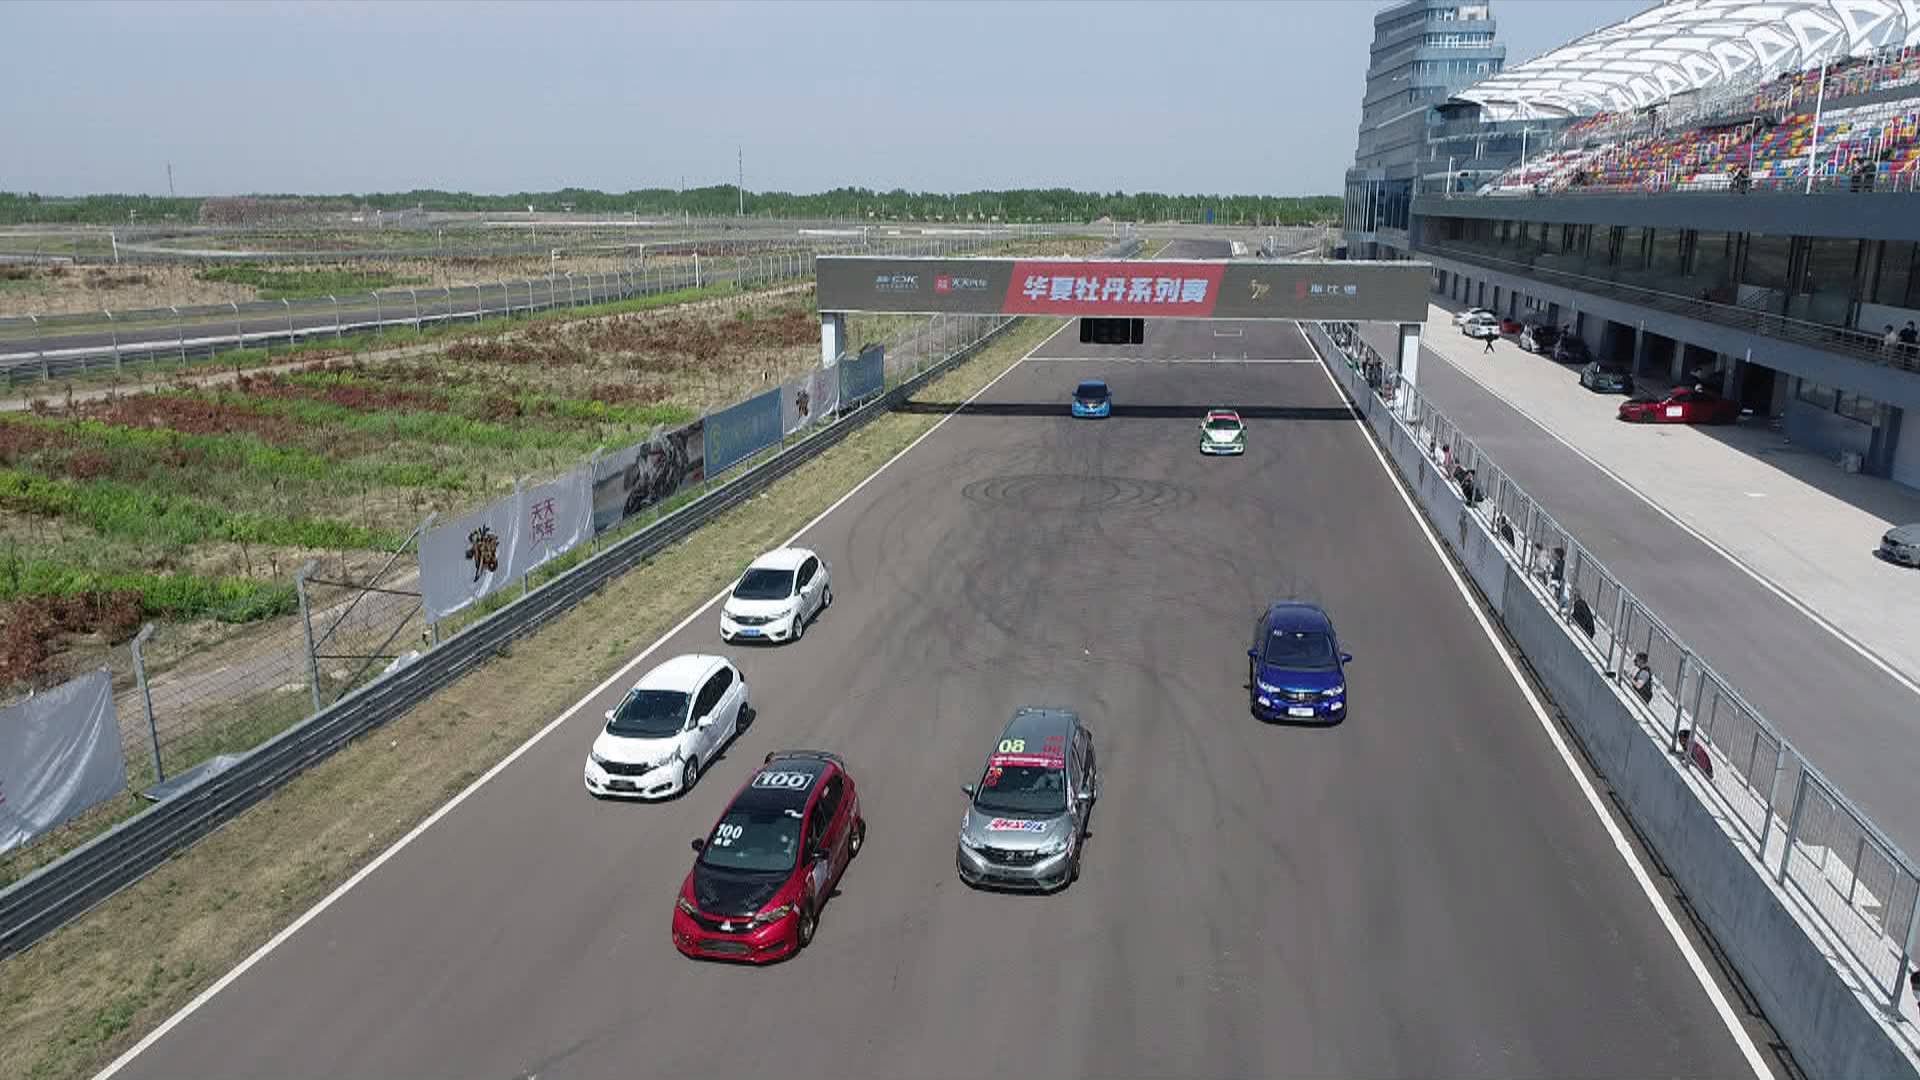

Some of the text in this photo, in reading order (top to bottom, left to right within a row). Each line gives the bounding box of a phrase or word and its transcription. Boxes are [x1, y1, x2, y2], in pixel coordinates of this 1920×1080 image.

[1022, 275, 1209, 303] 华夏牡丹系列赛
[998, 739, 1025, 753] 08
[761, 772, 805, 787] 100
[716, 823, 743, 839] 100
